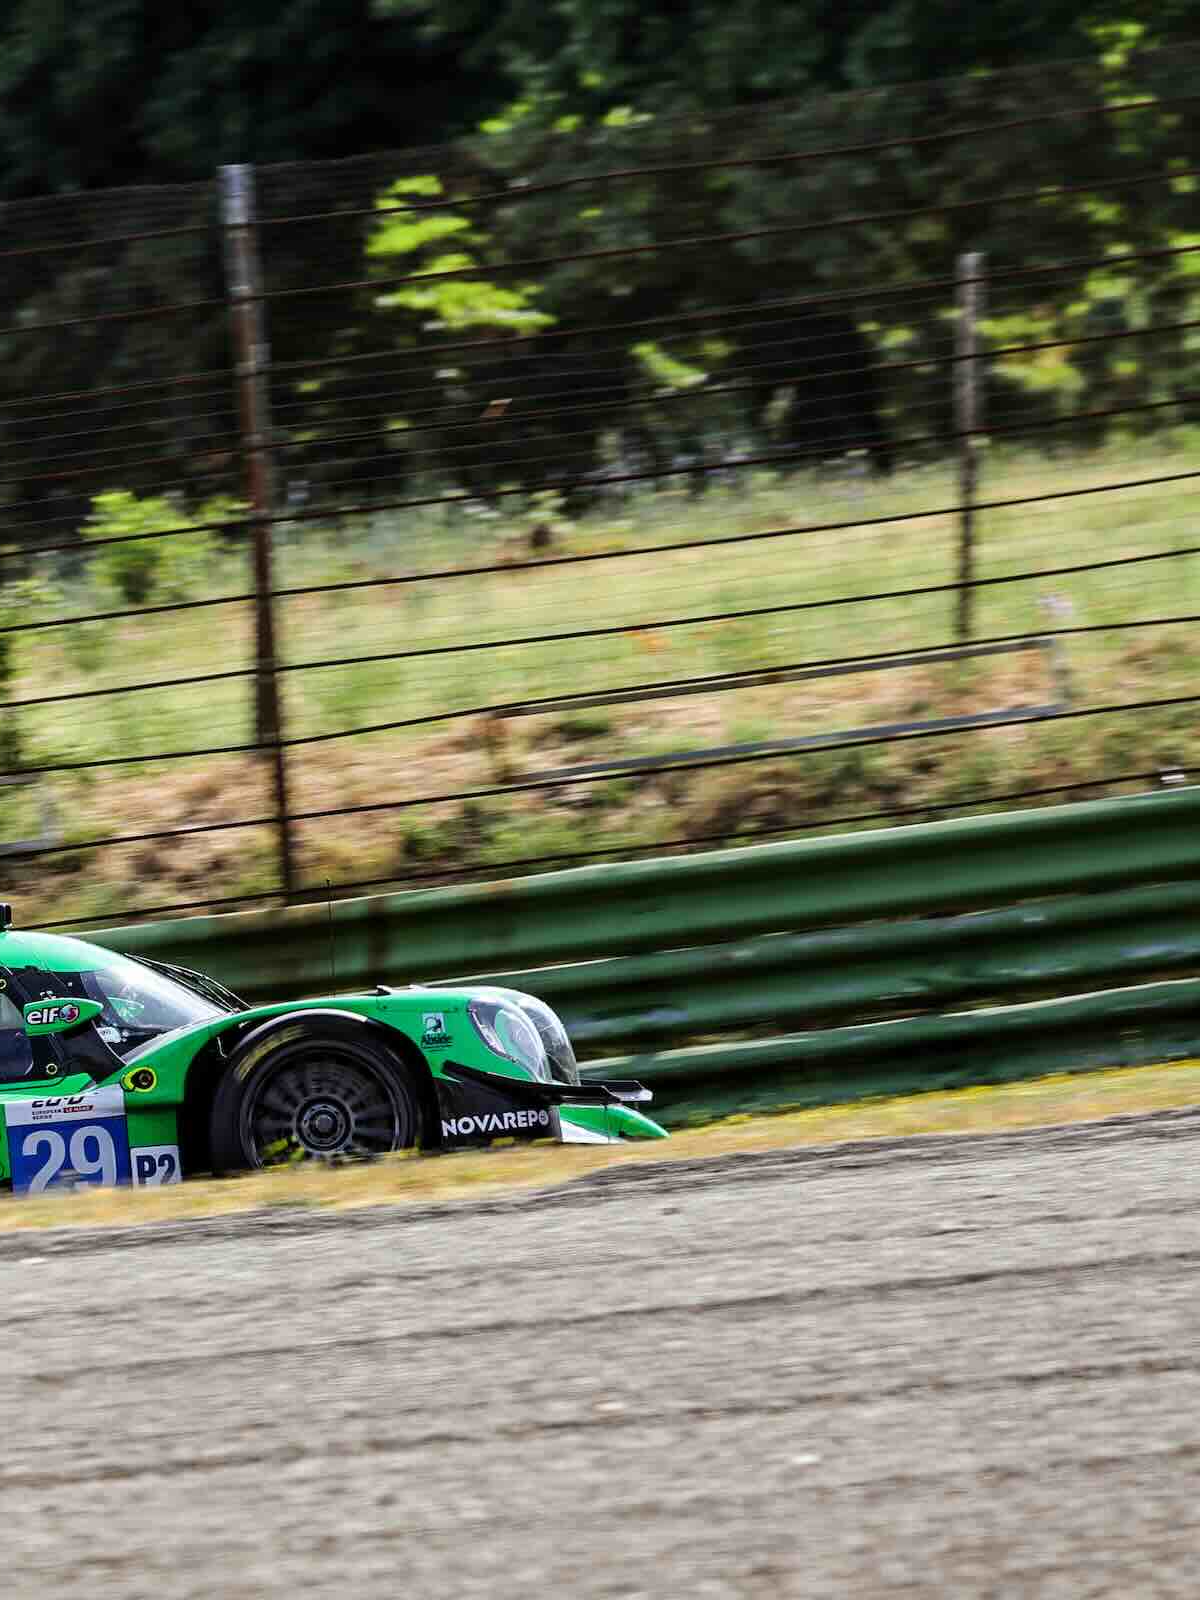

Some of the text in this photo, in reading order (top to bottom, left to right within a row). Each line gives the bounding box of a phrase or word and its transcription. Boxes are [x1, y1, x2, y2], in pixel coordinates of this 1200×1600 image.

[27, 1008, 60, 1024] elf
[22, 1125, 118, 1194] 29
[136, 1154, 176, 1185] P2
